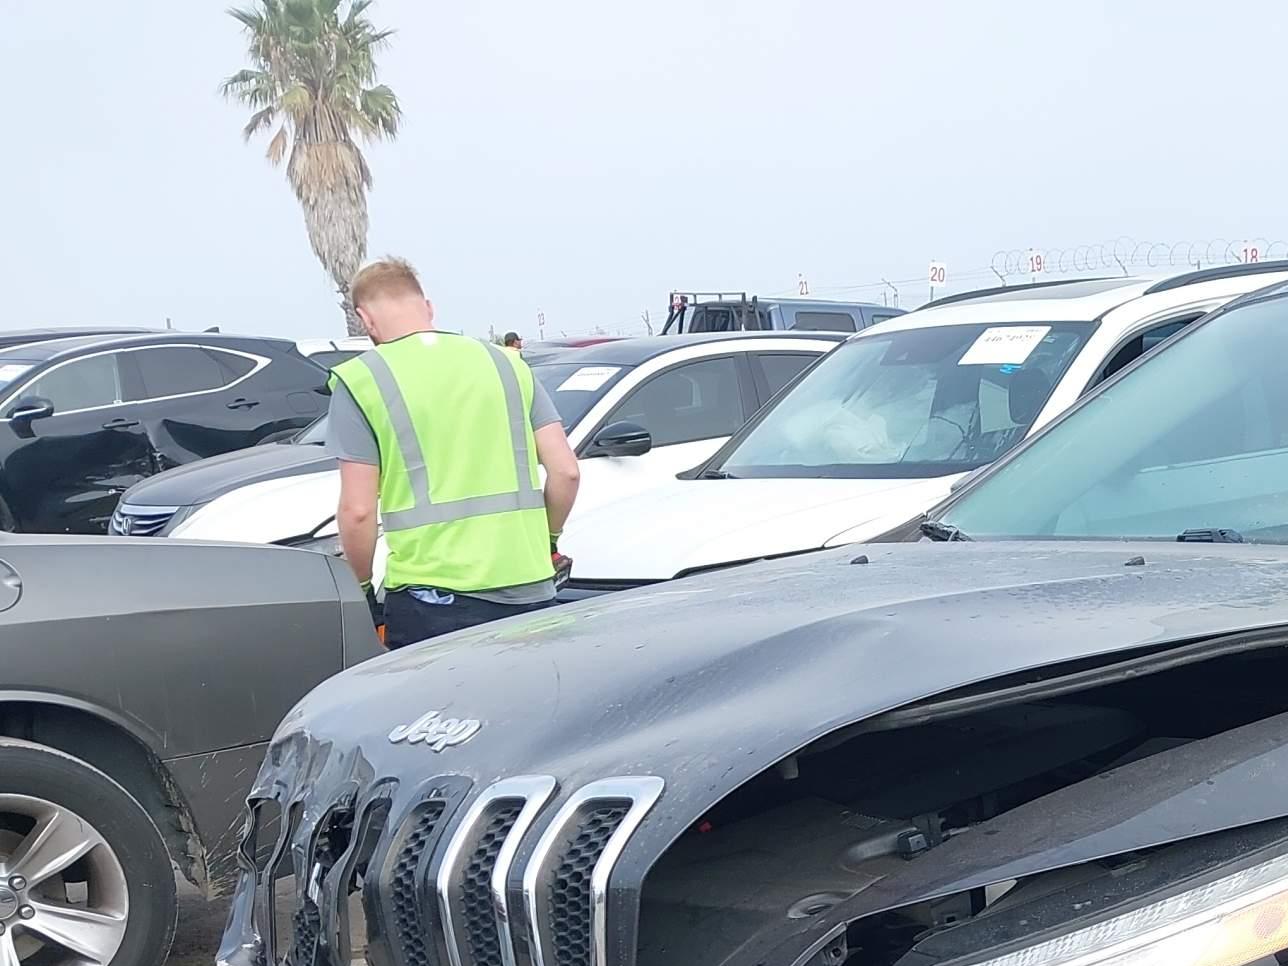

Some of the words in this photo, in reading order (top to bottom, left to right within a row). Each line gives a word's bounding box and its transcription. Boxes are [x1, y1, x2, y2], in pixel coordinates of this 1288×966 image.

[1030, 254, 1042, 273] 19
[1243, 248, 1258, 263] 18
[930, 266, 945, 283] 20
[799, 280, 809, 296] 21
[387, 710, 482, 753] Jeep
